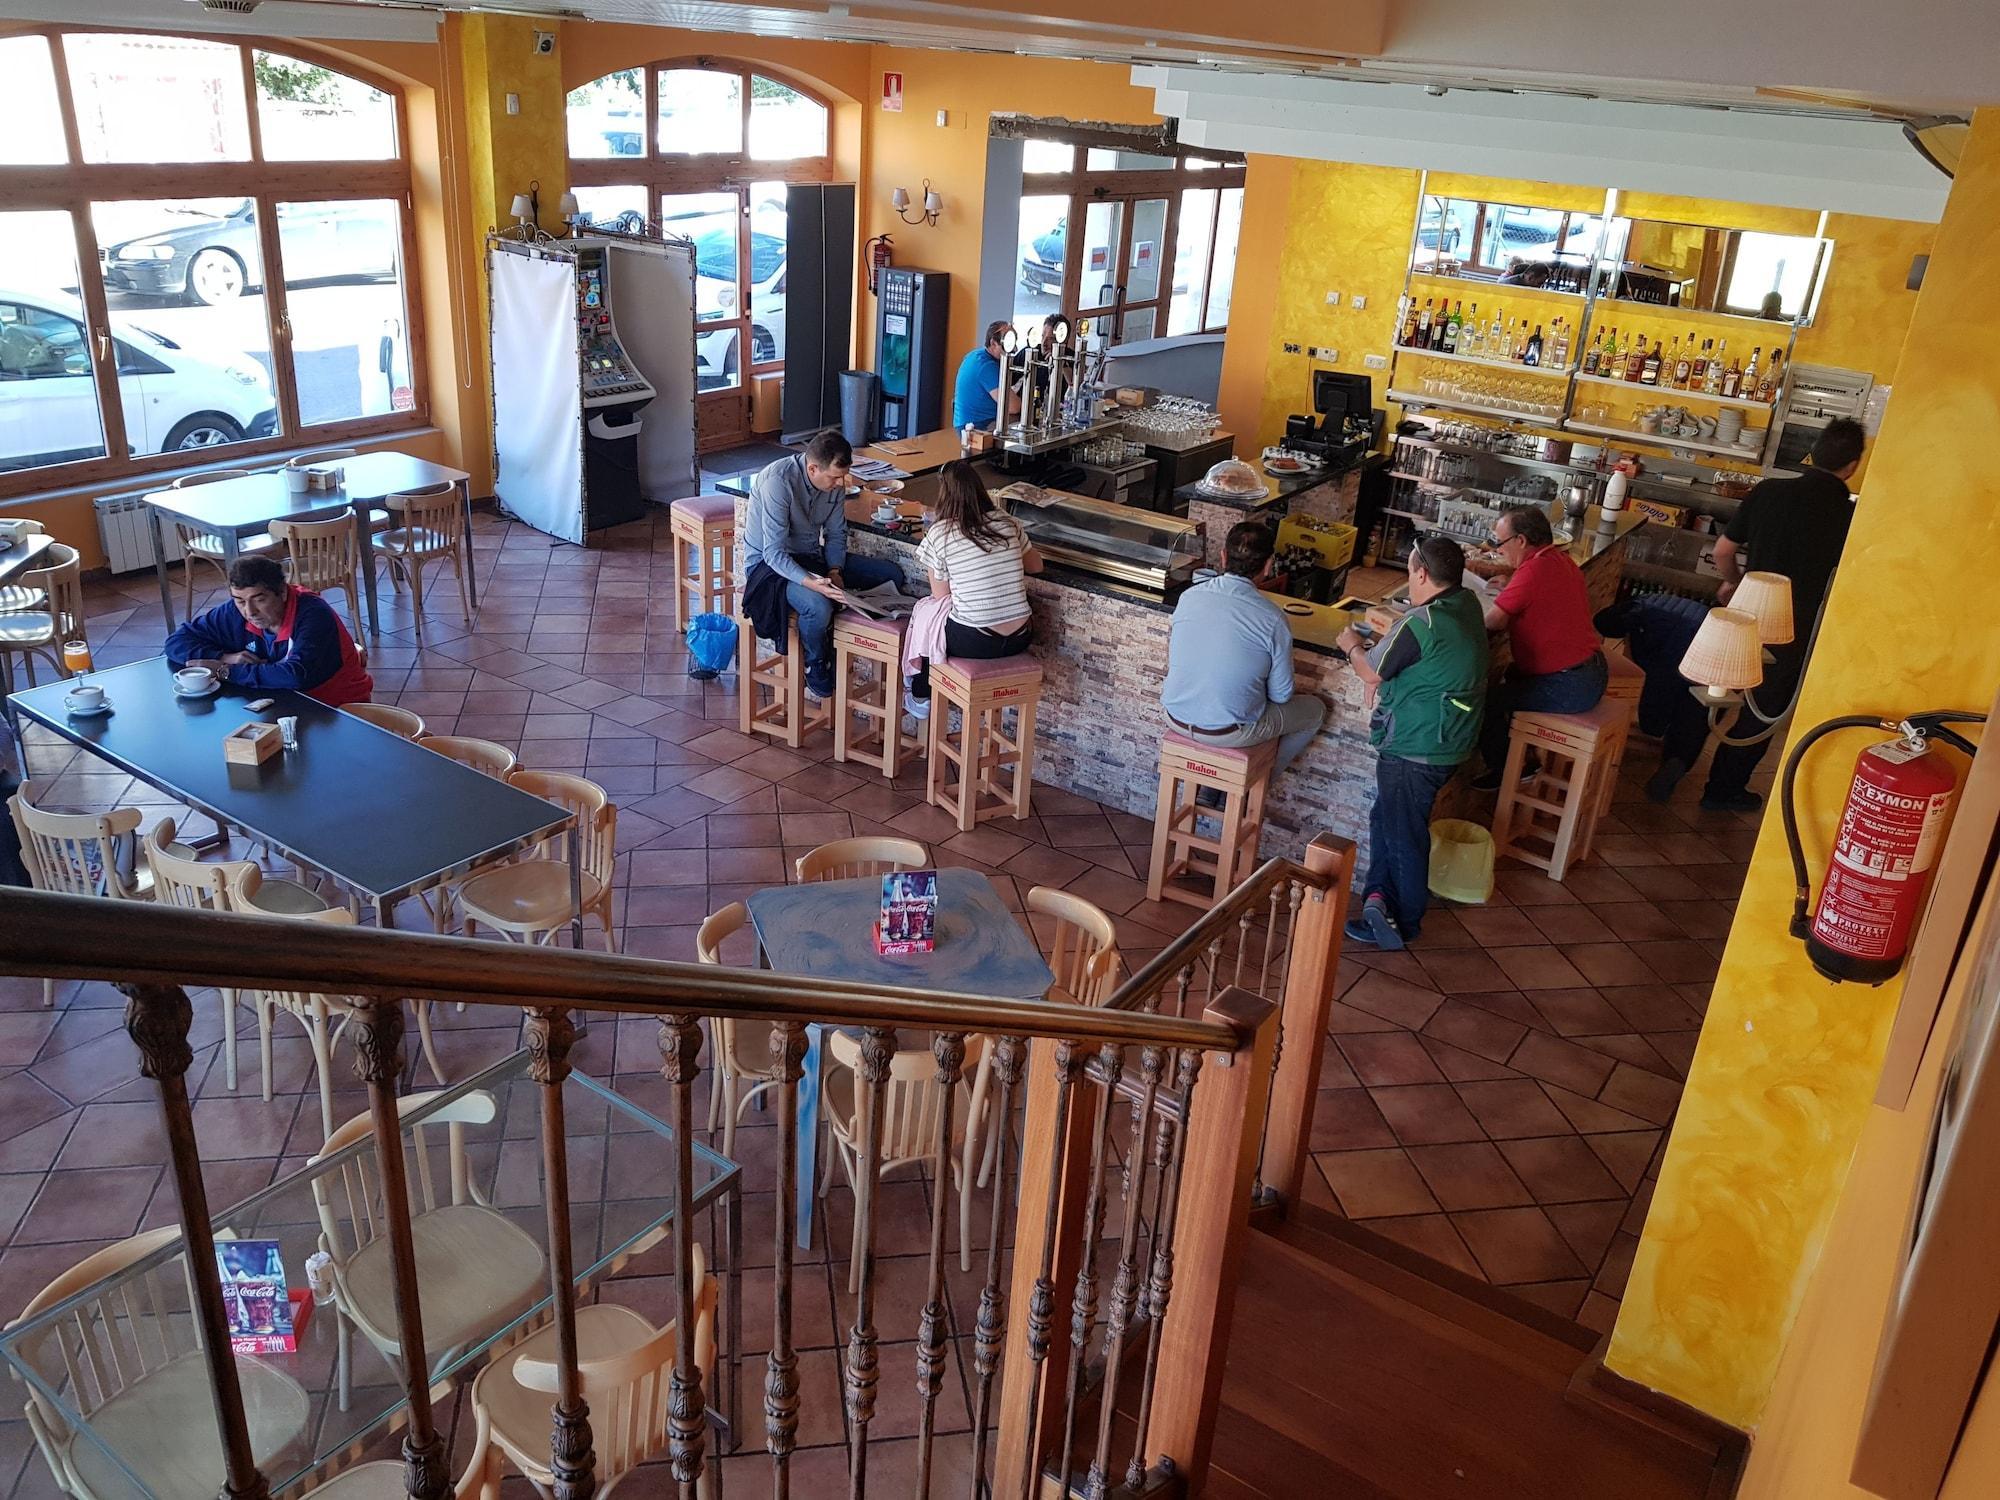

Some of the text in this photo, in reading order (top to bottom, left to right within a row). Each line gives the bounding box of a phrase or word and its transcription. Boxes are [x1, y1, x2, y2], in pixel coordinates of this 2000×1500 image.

[854, 636, 878, 649] Mahou
[992, 687, 1019, 698] Mahou
[1537, 727, 1567, 743] Mahou
[1186, 761, 1217, 776] Mahou
[1866, 788, 1925, 811] EXMON
